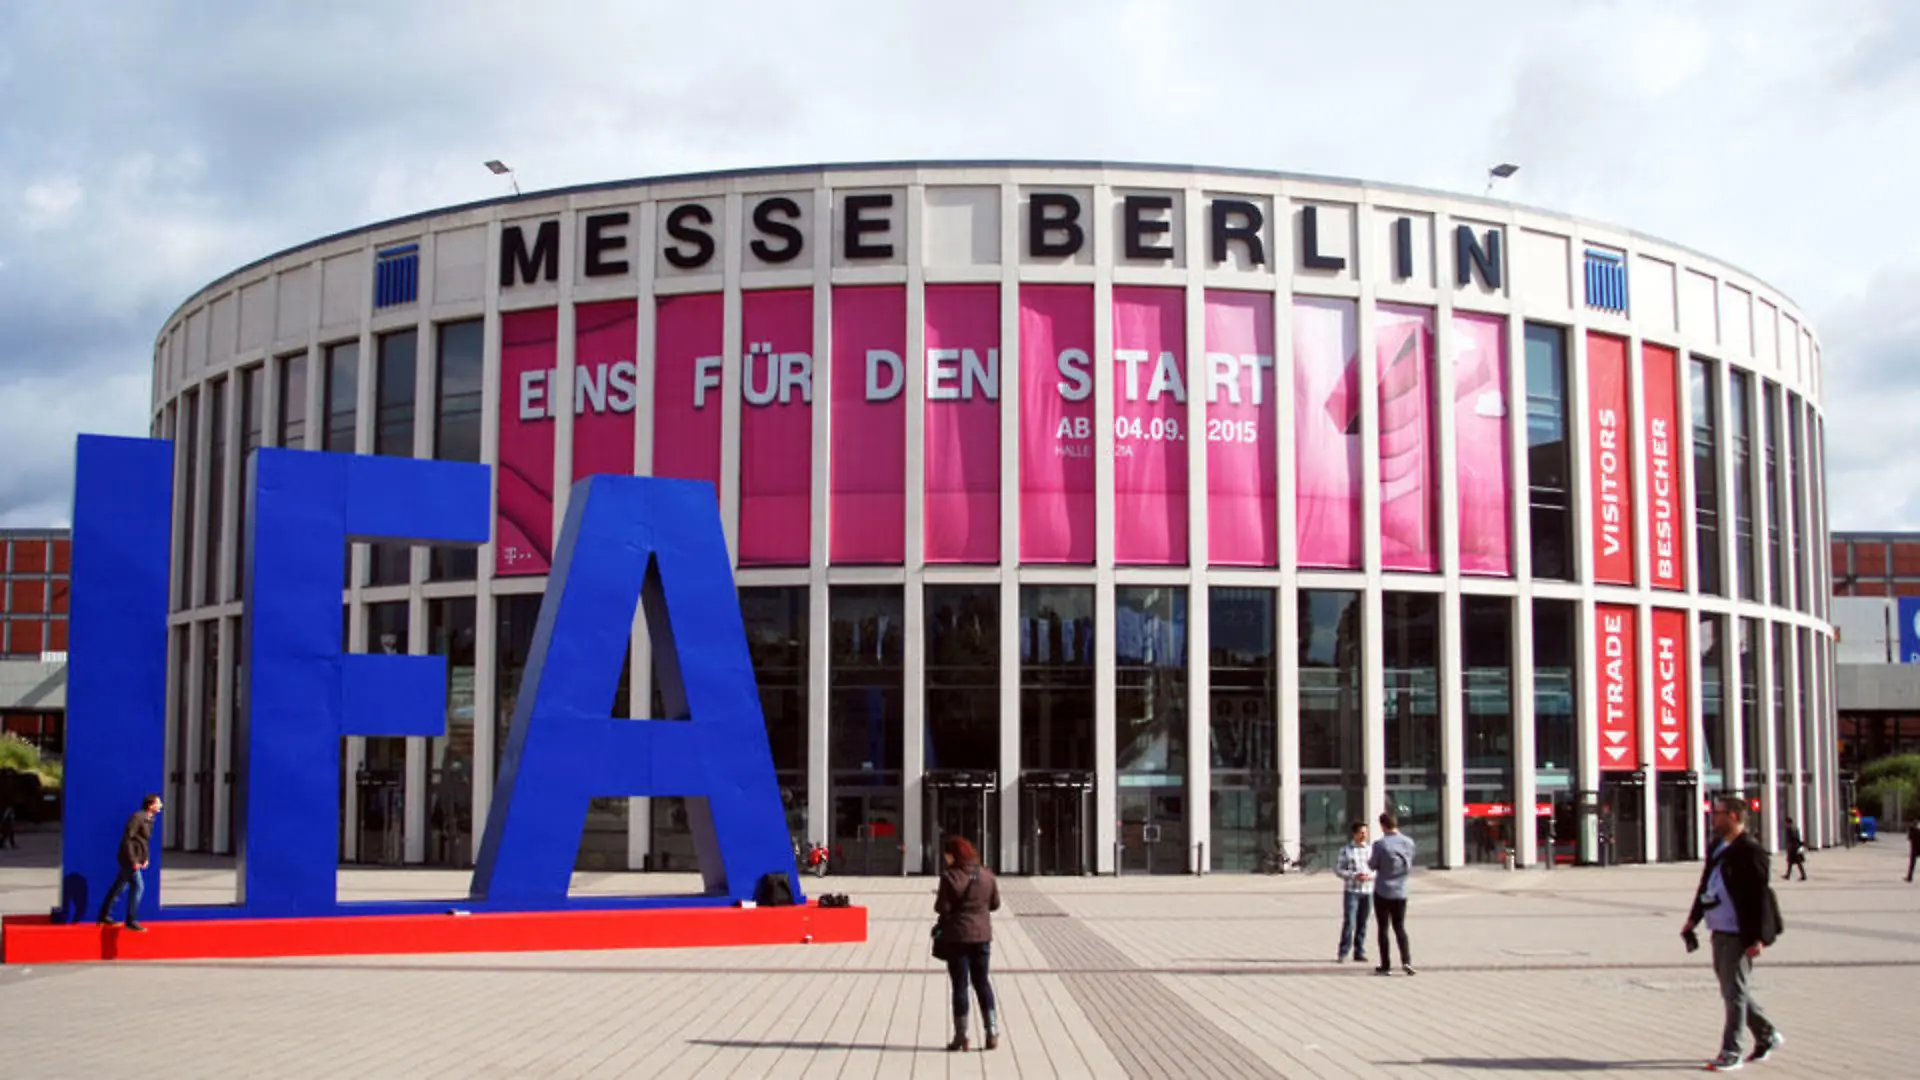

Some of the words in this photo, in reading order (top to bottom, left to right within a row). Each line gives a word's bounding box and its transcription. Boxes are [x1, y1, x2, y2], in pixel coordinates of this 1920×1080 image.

[501, 194, 893, 286] MESSE
[1029, 193, 1500, 288] BERLIN
[519, 360, 636, 420] EINS
[693, 342, 813, 408] FÜR
[865, 347, 999, 400] DEN
[1056, 347, 1273, 405] START
[1056, 416, 1091, 439] AB
[1115, 416, 1184, 441] 04.09.
[1208, 419, 1257, 443] 2015
[1600, 409, 1619, 556] VISITORS
[1651, 419, 1672, 578] BESUCHER
[60, 433, 803, 922] IFA
[1606, 615, 1623, 723] TRADE
[1659, 637, 1677, 726] FACH
